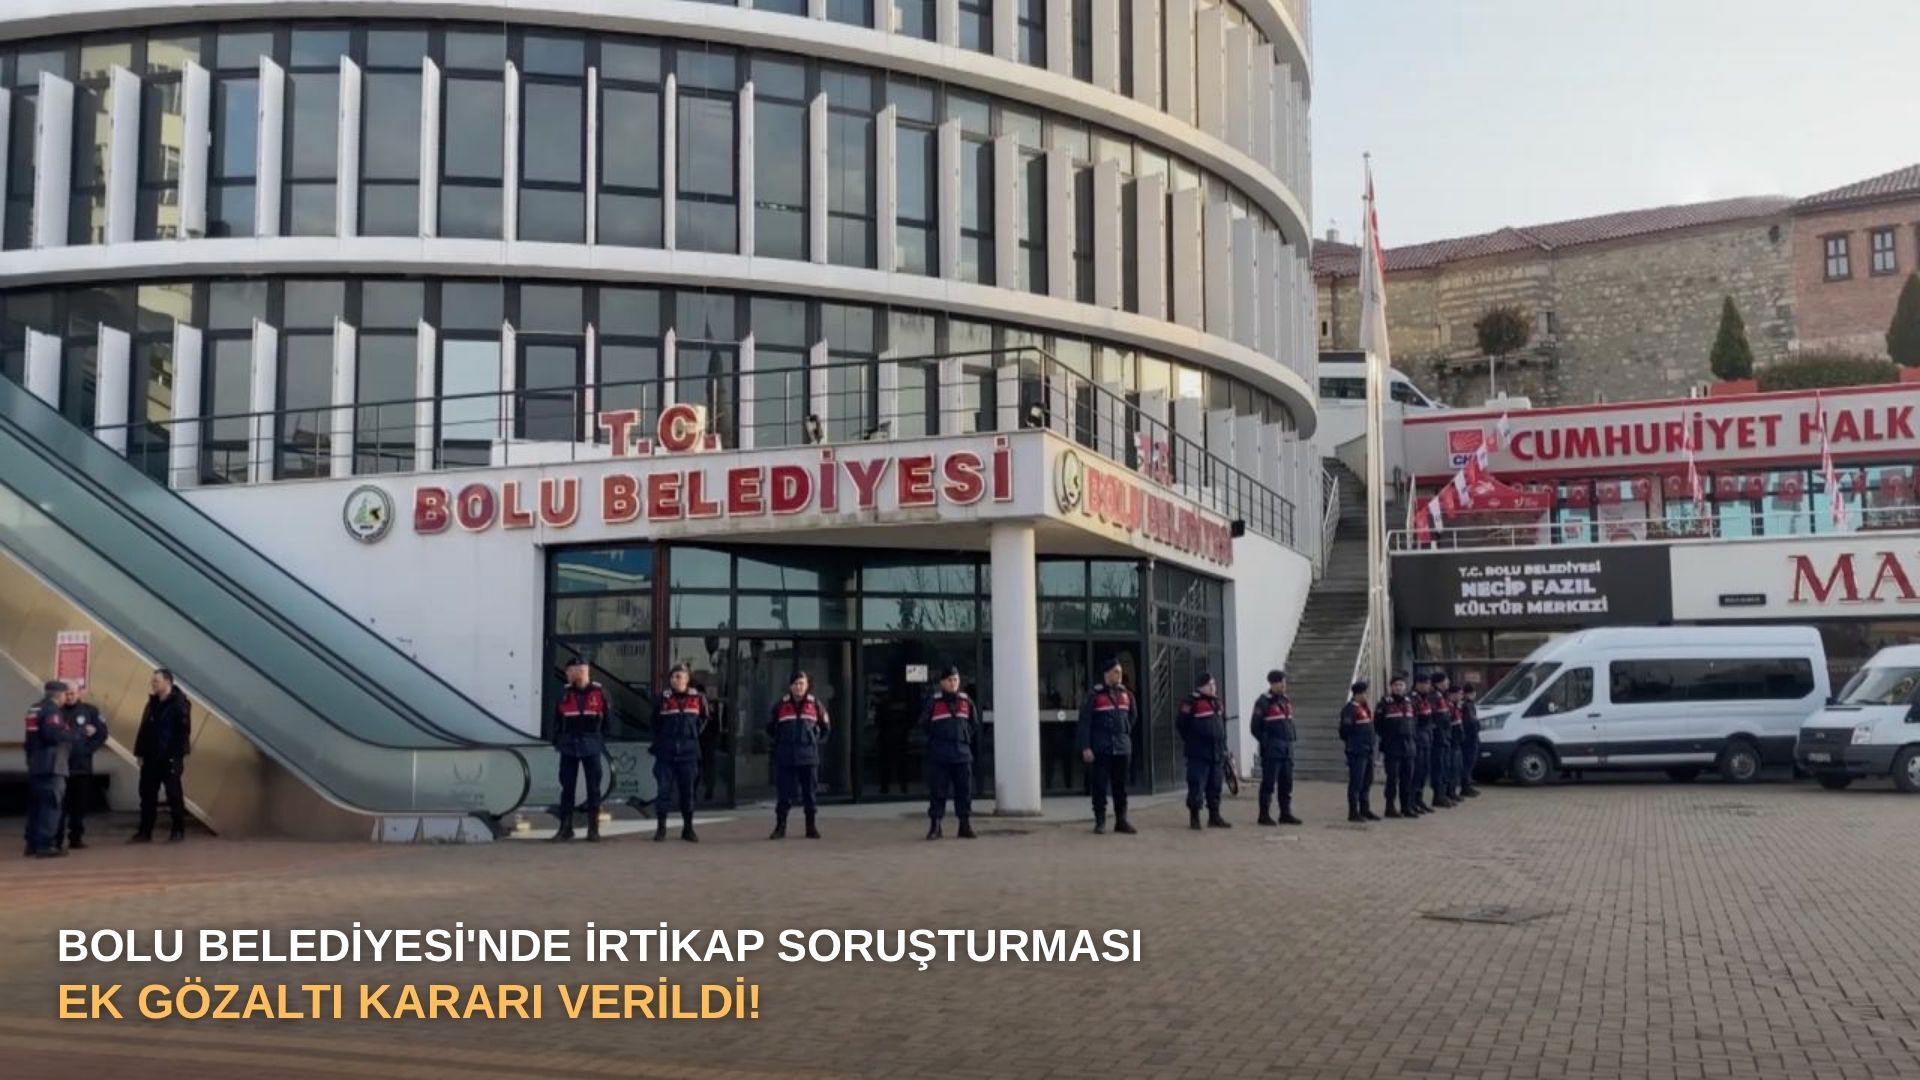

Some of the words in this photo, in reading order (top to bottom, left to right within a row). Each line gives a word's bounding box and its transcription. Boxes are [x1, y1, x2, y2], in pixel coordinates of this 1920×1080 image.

[599, 403, 721, 457] T.C.
[1510, 412, 1783, 461] CUMHURİYET
[1800, 406, 1915, 445] HALK
[413, 476, 580, 535] BOLU
[602, 437, 1013, 524] BELEDİYESİ
[1461, 576, 1527, 597] NECİP
[1531, 578, 1597, 596] FAZIL
[1485, 564, 1522, 577] BOLU
[1524, 560, 1601, 575] BELEDİYESİ
[1788, 550, 1920, 604] MA
[1454, 599, 1523, 616] KÜLTÜR
[1527, 595, 1609, 614] MERKEZİ
